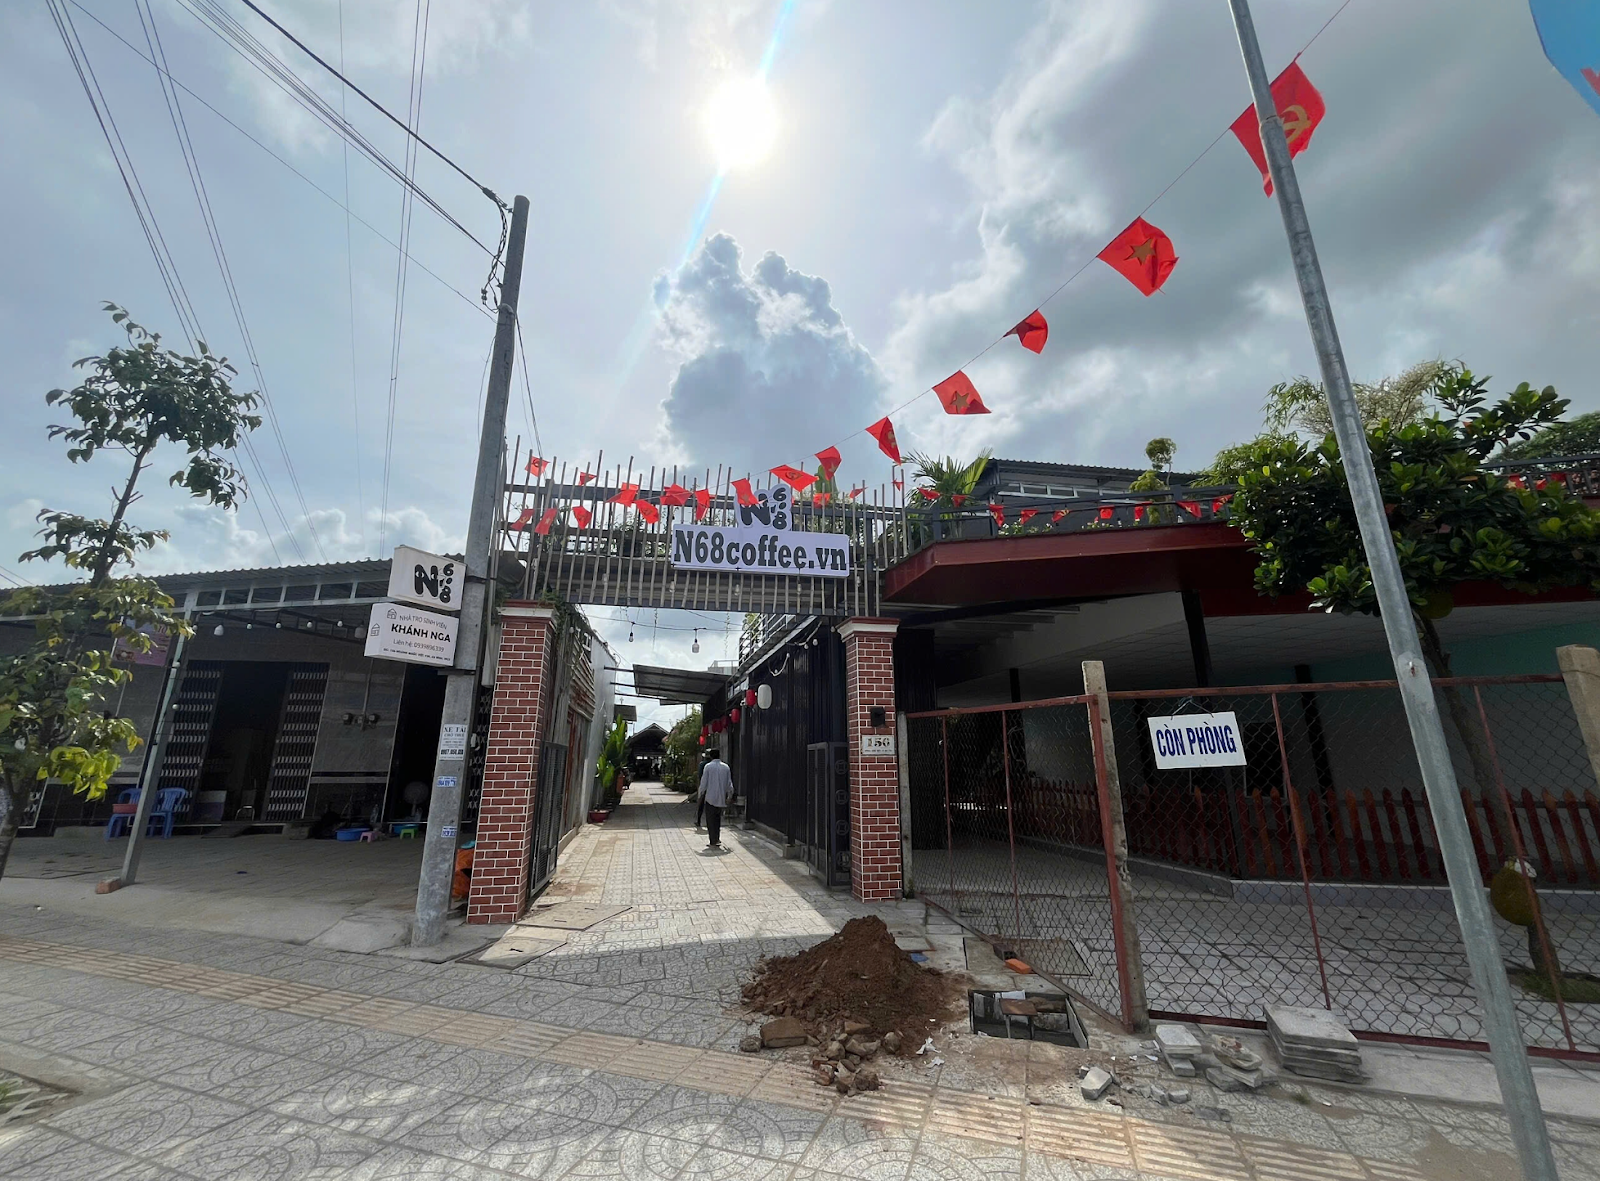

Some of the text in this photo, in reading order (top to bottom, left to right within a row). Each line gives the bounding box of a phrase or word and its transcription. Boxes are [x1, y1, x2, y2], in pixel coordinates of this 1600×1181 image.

[673, 529, 847, 571] N68coffee.vn
[391, 623, 451, 643] KHÁNH NGA
[1156, 721, 1237, 757] CÒN PHÒNG
